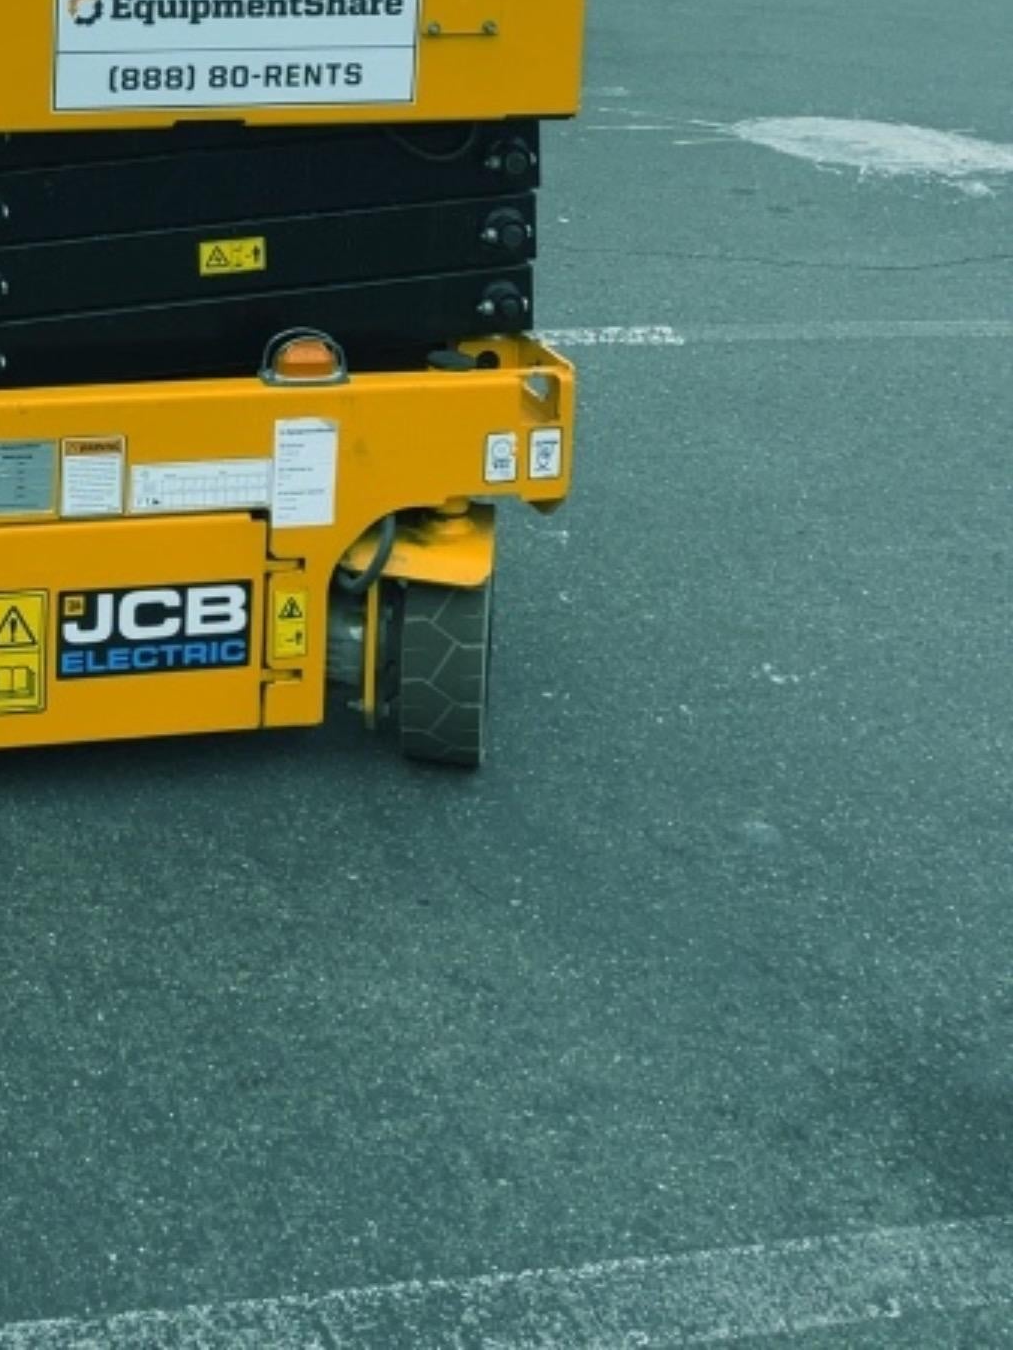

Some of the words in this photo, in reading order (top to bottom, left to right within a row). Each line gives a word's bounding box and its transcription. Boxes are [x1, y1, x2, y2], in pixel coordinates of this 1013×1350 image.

[108, 64, 196, 93] (888)
[208, 62, 363, 89] 80-RENTS
[62, 585, 247, 644] JCB
[60, 639, 246, 674] ELECTRIC
